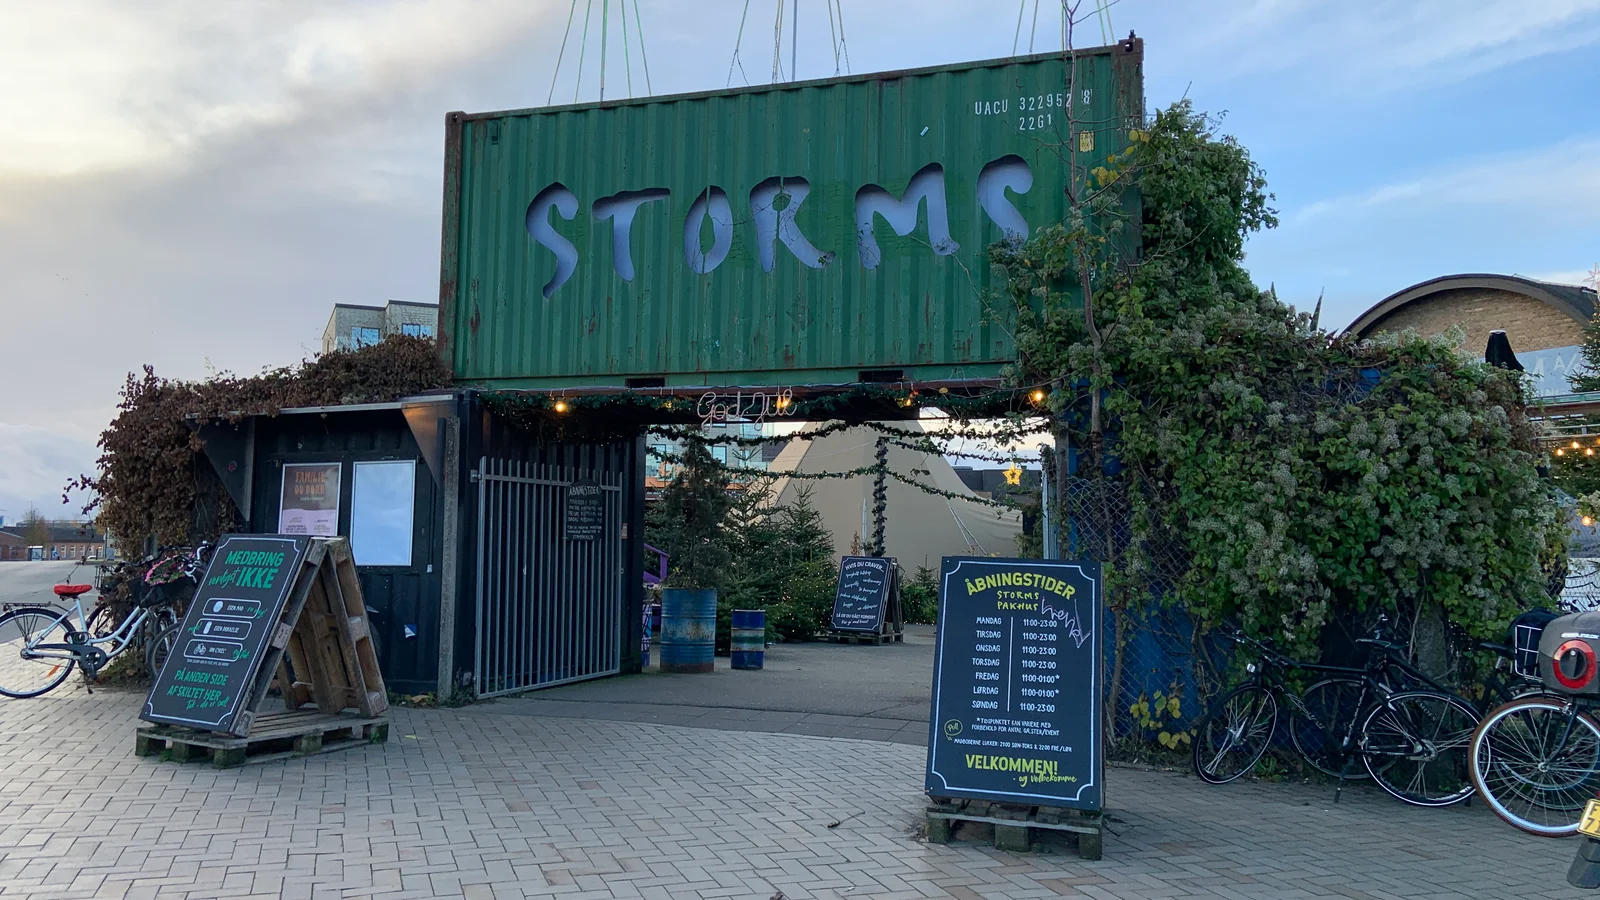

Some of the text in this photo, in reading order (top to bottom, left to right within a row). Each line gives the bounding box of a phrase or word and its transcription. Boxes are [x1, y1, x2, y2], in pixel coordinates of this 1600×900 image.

[974, 89, 1092, 115] UACU 322952 8
[1019, 113, 1052, 131] 22G1
[525, 154, 1034, 299] STORMS
[697, 391, 741, 433] God
[224, 550, 285, 567] MEDBRING
[844, 562, 857, 571] HVIS
[236, 567, 279, 589] IKKE
[964, 572, 1077, 600] ÅBNINGSTIDER
[996, 590, 1040, 600] STORMS
[997, 601, 1039, 611] PAKHUS
[975, 616, 1058, 628] MANDAG 11:00-23:00
[976, 630, 1057, 641] TIRSDAG 11:00-23:00
[975, 644, 1057, 655] ONSDAG 11:00-23:00
[971, 657, 1057, 669] TORSDAG 11:00-23:00
[174, 667, 229, 686] PÅ ANDEN SIDE
[975, 672, 1000, 681] FREDAG
[167, 685, 222, 701] AF SKILTET HER
[973, 686, 999, 695] LØRDAG
[971, 700, 1056, 713] SØNDAG 11:00-23:00
[1007, 726, 1022, 734] ANTAL
[965, 754, 1058, 775] VELKOMMEN!
[1018, 775, 1028, 788] og
[1030, 770, 1078, 783] velbekomme
